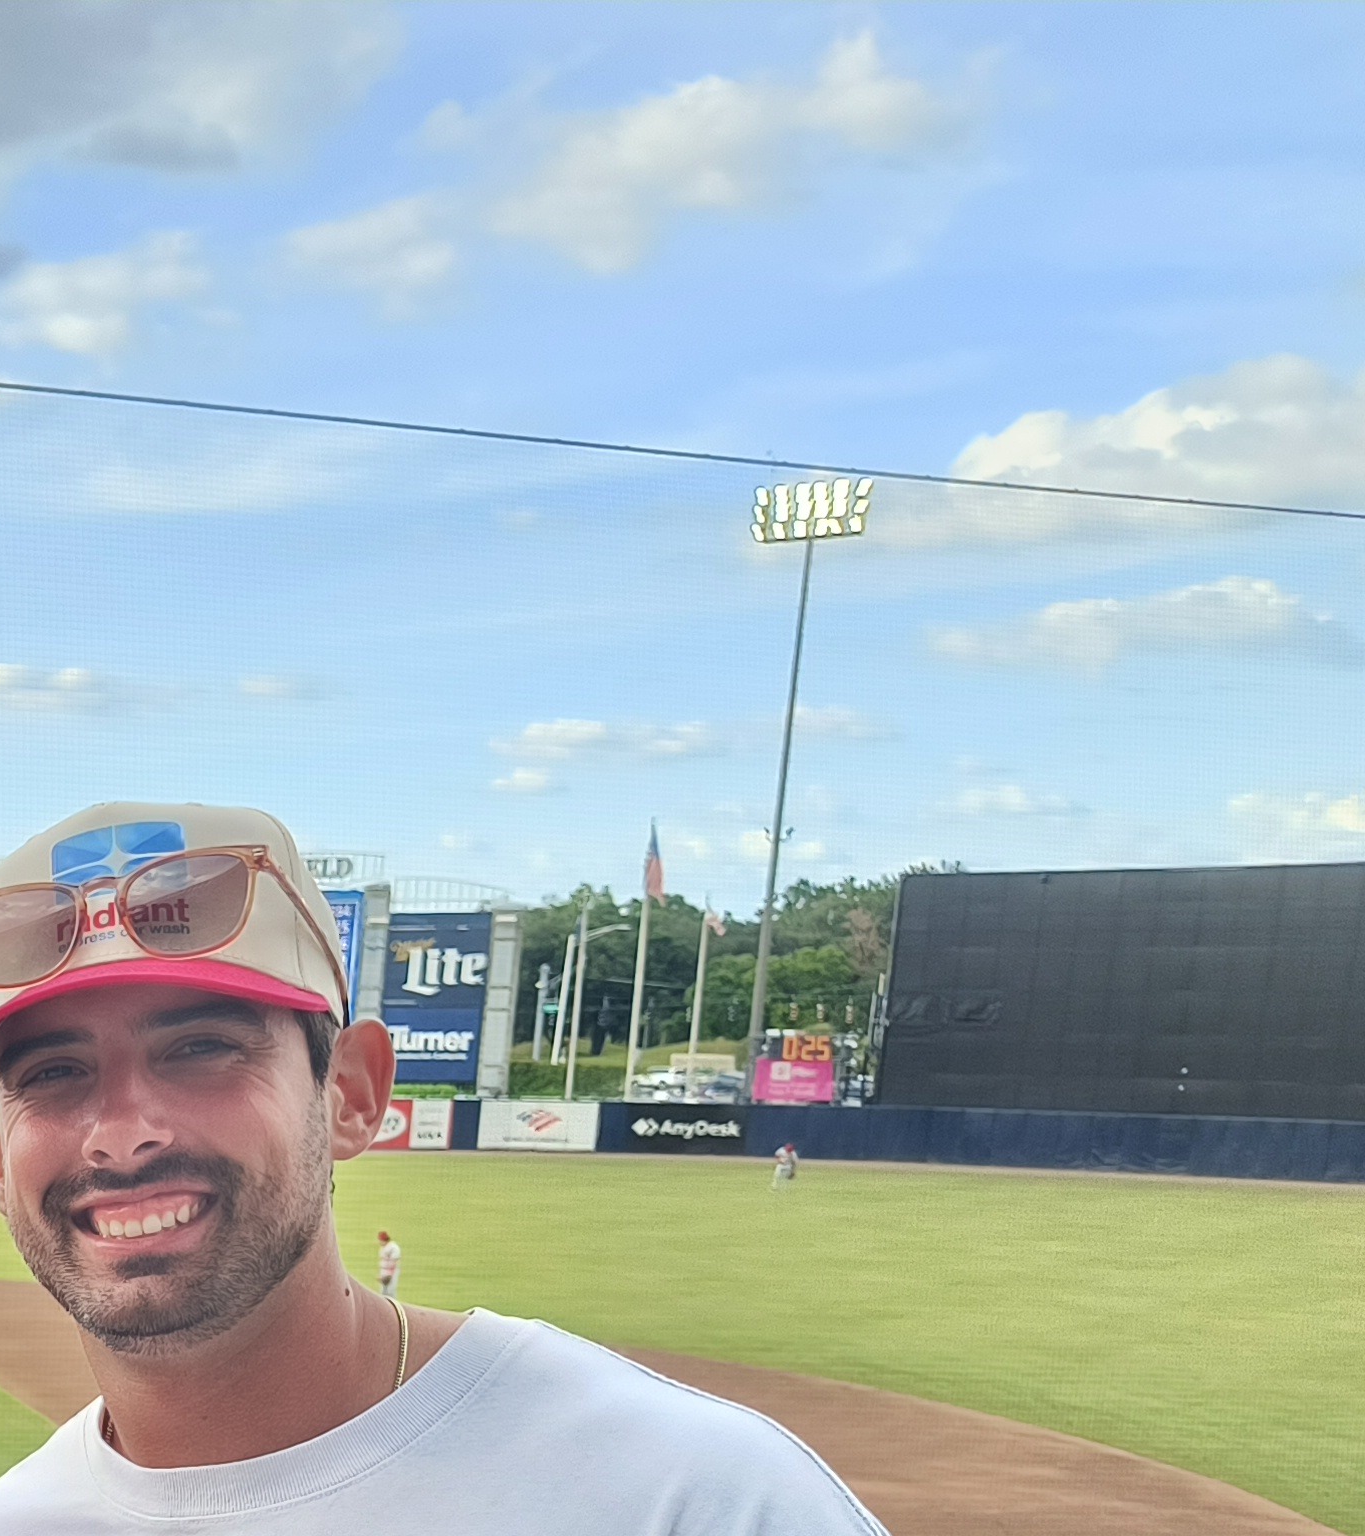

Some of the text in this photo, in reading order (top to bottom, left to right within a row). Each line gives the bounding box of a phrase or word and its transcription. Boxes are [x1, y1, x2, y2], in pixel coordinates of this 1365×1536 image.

[305, 857, 354, 879] ELD
[58, 923, 191, 954] eress cr wash
[401, 946, 488, 996] Lite
[387, 1024, 475, 1052] Turner
[782, 1035, 832, 1062] 0:25
[658, 1118, 742, 1140] AnyDesk
